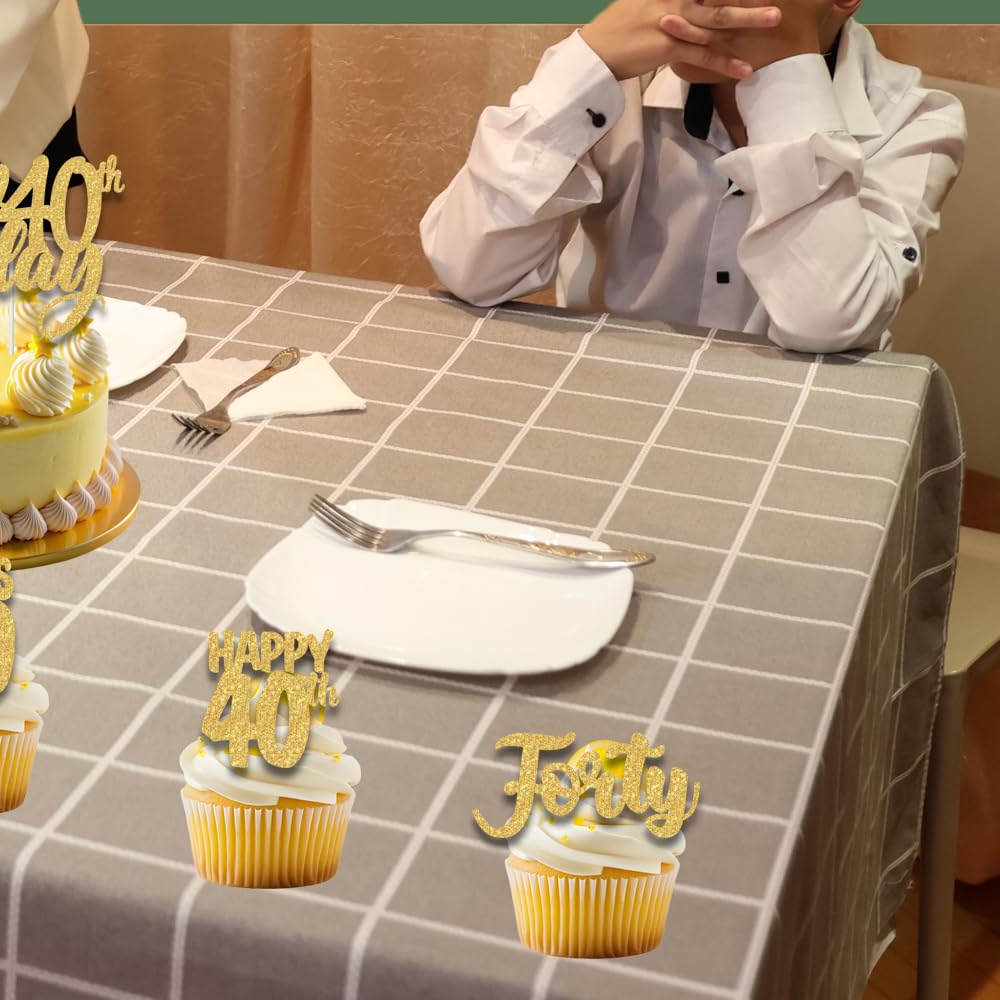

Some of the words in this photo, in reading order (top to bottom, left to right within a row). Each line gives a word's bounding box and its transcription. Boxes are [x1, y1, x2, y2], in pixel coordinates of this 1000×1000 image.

[207, 629, 335, 674] HAPPY
[201, 670, 342, 769] 40th
[473, 730, 701, 840] Forty
